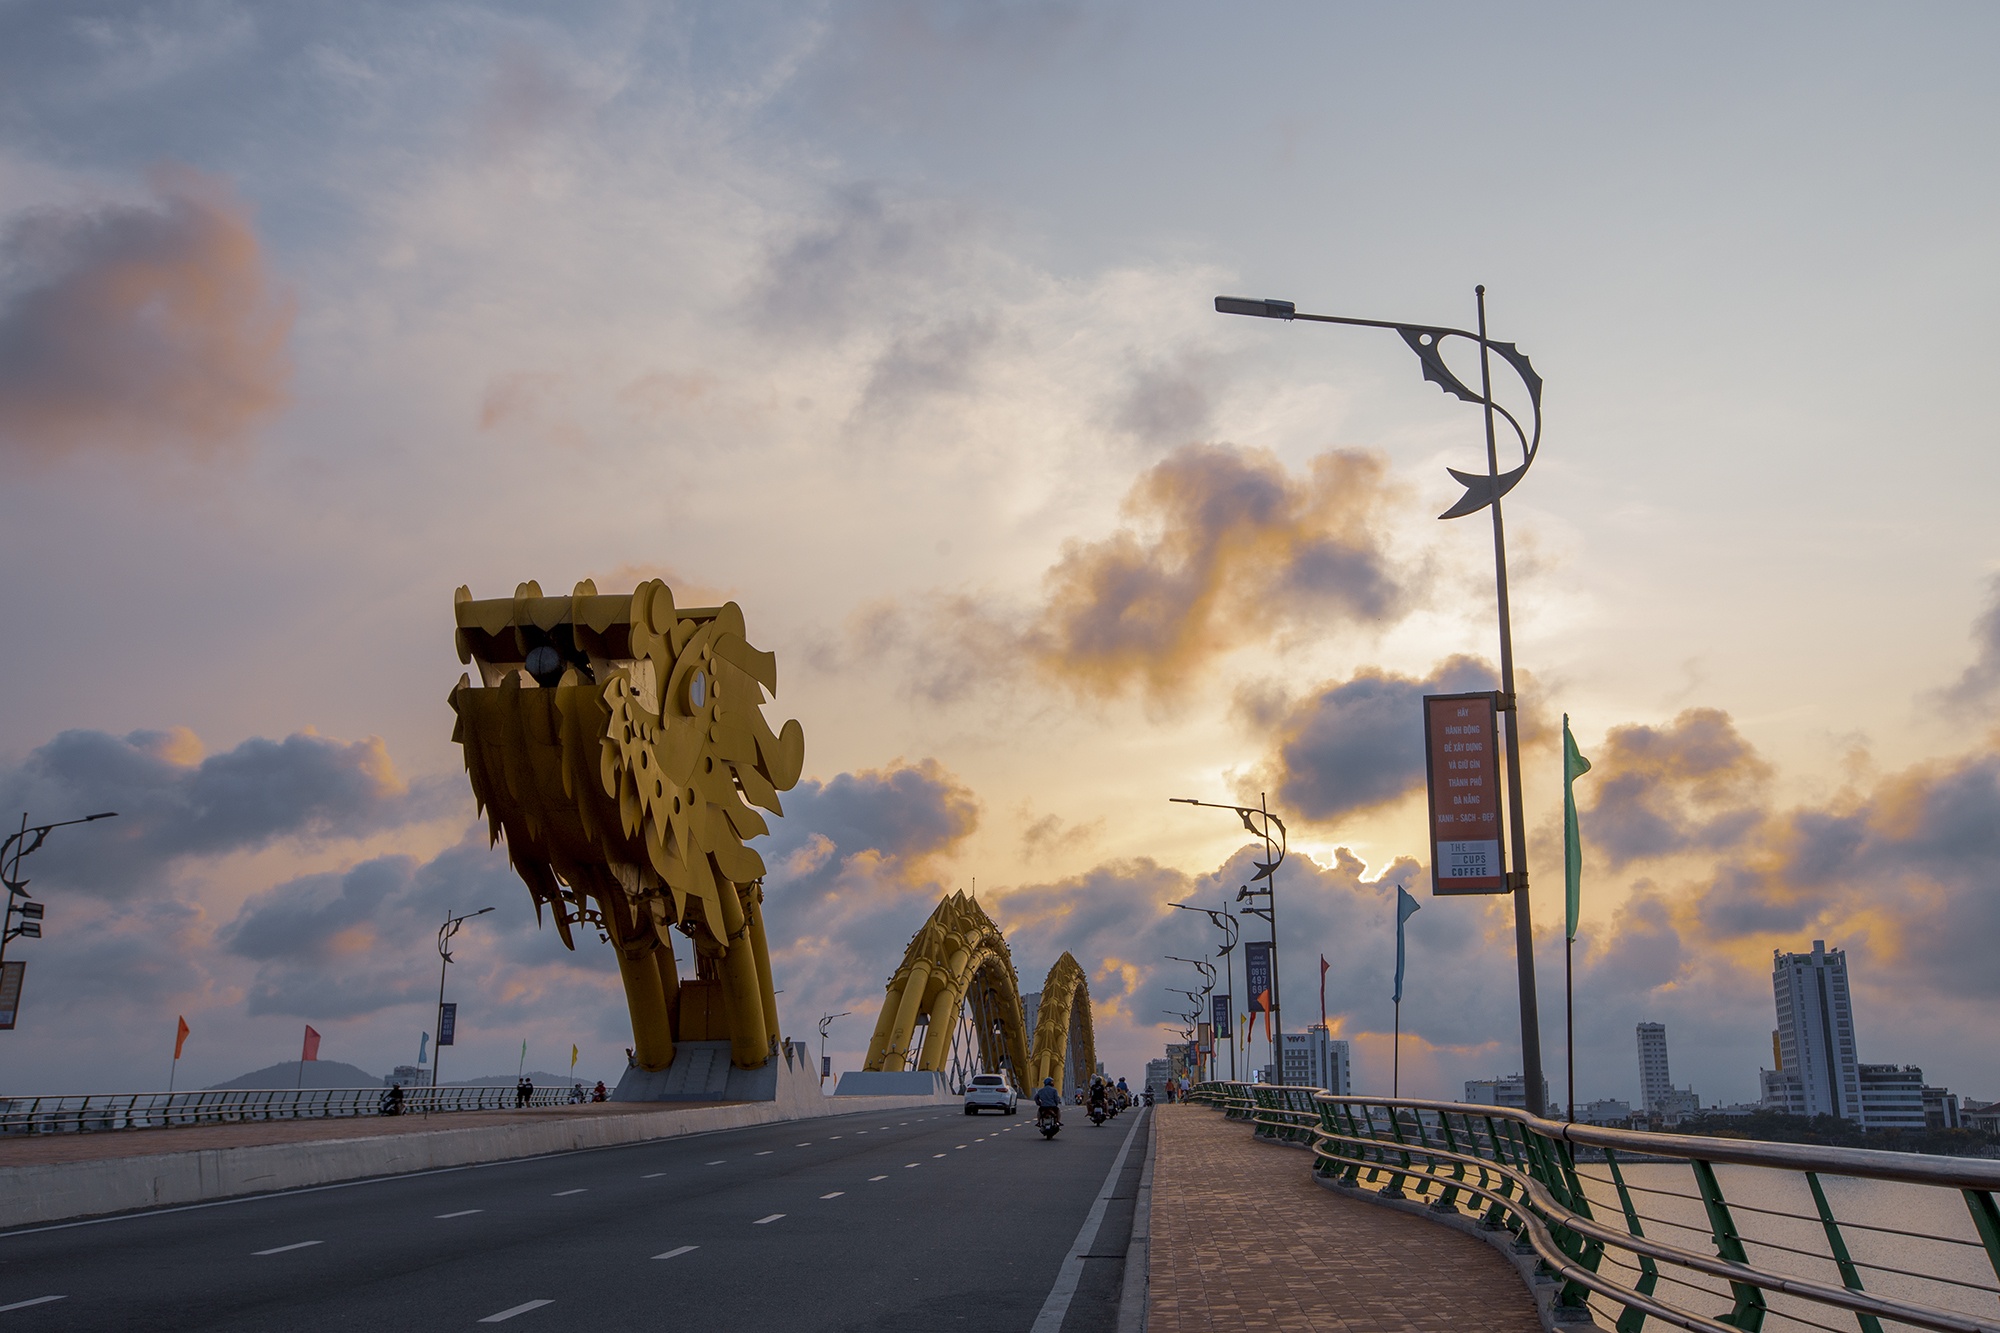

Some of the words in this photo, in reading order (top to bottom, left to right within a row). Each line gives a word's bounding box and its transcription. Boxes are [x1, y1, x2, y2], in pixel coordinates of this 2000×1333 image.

[1457, 708, 1468, 716] HÃY
[1446, 726, 1462, 734] HÀNH
[1464, 725, 1480, 734] ĐỘNG
[1449, 760, 1456, 769] VÀ
[1470, 759, 1480, 768] GÌN
[1449, 777, 1468, 787] THÀNH
[1470, 776, 1482, 786] PHỐ
[1438, 815, 1454, 823] XANH
[1460, 814, 1476, 823] SẠCH
[1482, 813, 1494, 823] ĐẸP
[1451, 843, 1466, 852] THE
[1463, 855, 1486, 864] CUPS
[1452, 867, 1486, 876] COFFEE
[1252, 976, 1266, 984] 497
